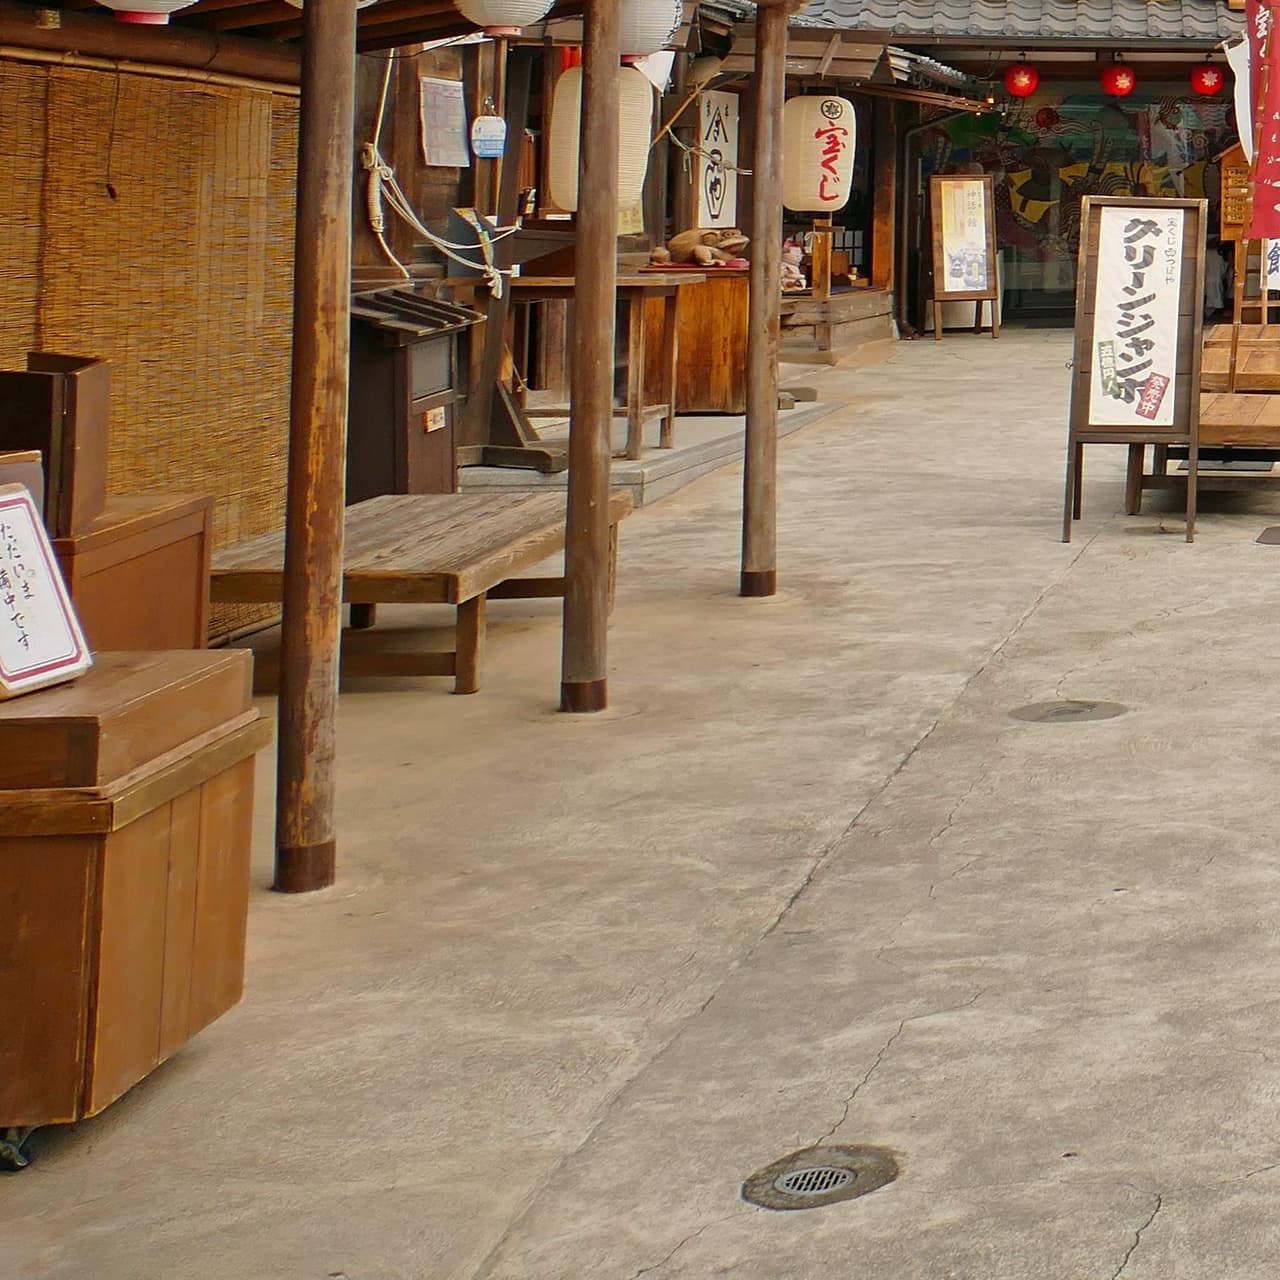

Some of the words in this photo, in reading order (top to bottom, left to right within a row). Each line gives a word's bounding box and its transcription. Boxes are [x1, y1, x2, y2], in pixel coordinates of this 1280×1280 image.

[814, 120, 849, 202] 宝くじ
[1116, 218, 1163, 404] グリーンジャンボ
